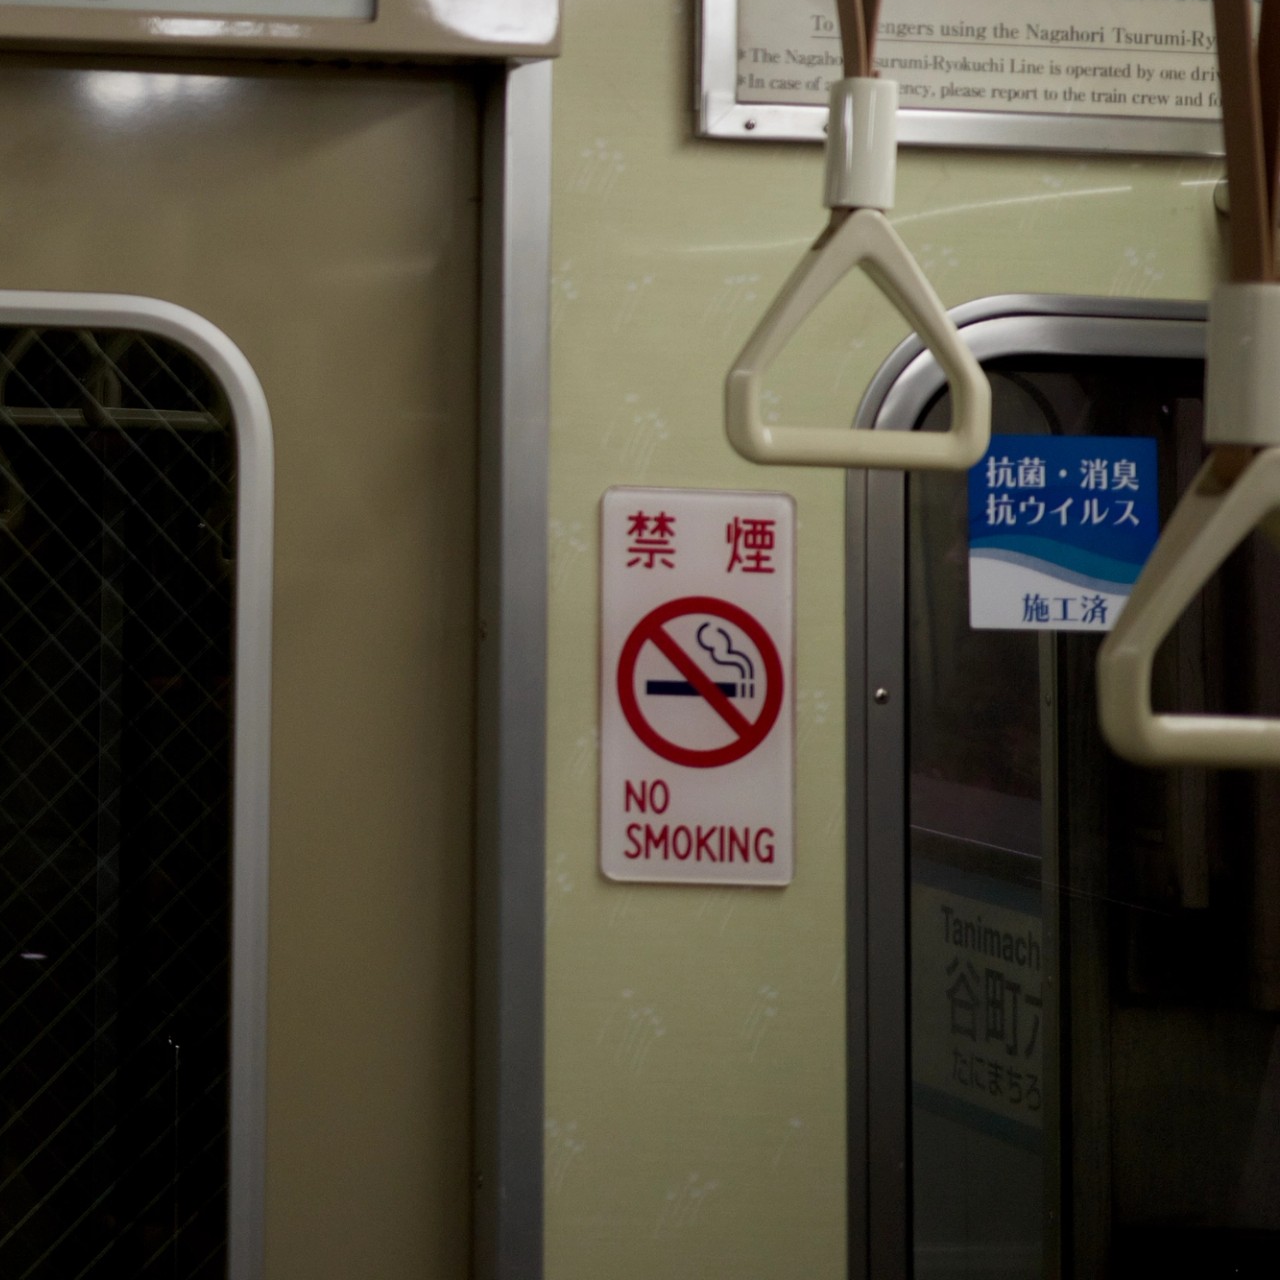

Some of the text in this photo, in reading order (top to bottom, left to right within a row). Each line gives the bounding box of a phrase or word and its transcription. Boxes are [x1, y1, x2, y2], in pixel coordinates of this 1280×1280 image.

[810, 14, 833, 33] To
[940, 20, 987, 40] using
[993, 23, 1020, 40] the
[1025, 24, 1105, 45] Nagahori
[748, 48, 781, 65] The
[784, 50, 844, 71] Nagaho
[874, 54, 1005, 74] surumi-Ryokuchi
[1009, 58, 1045, 74] Line
[1049, 59, 1062, 75] is
[1066, 62, 1131, 81] operated
[1136, 64, 1155, 82] by
[1160, 67, 1187, 81] one
[748, 72, 765, 89] In
[769, 76, 802, 91] case
[805, 74, 823, 91] of
[941, 81, 987, 100] please
[991, 85, 1038, 102] report
[1044, 86, 1058, 101] to
[1063, 85, 1086, 103] the
[1091, 87, 1128, 105] train
[1132, 91, 1170, 106] crew
[1175, 90, 1203, 107] and
[984, 456, 1140, 492] 抗菌・消臭
[984, 492, 1140, 528] 抗ウイルス
[1020, 591, 1110, 626] 施工済
[624, 777, 670, 816] NO
[623, 823, 776, 865] SMOKING
